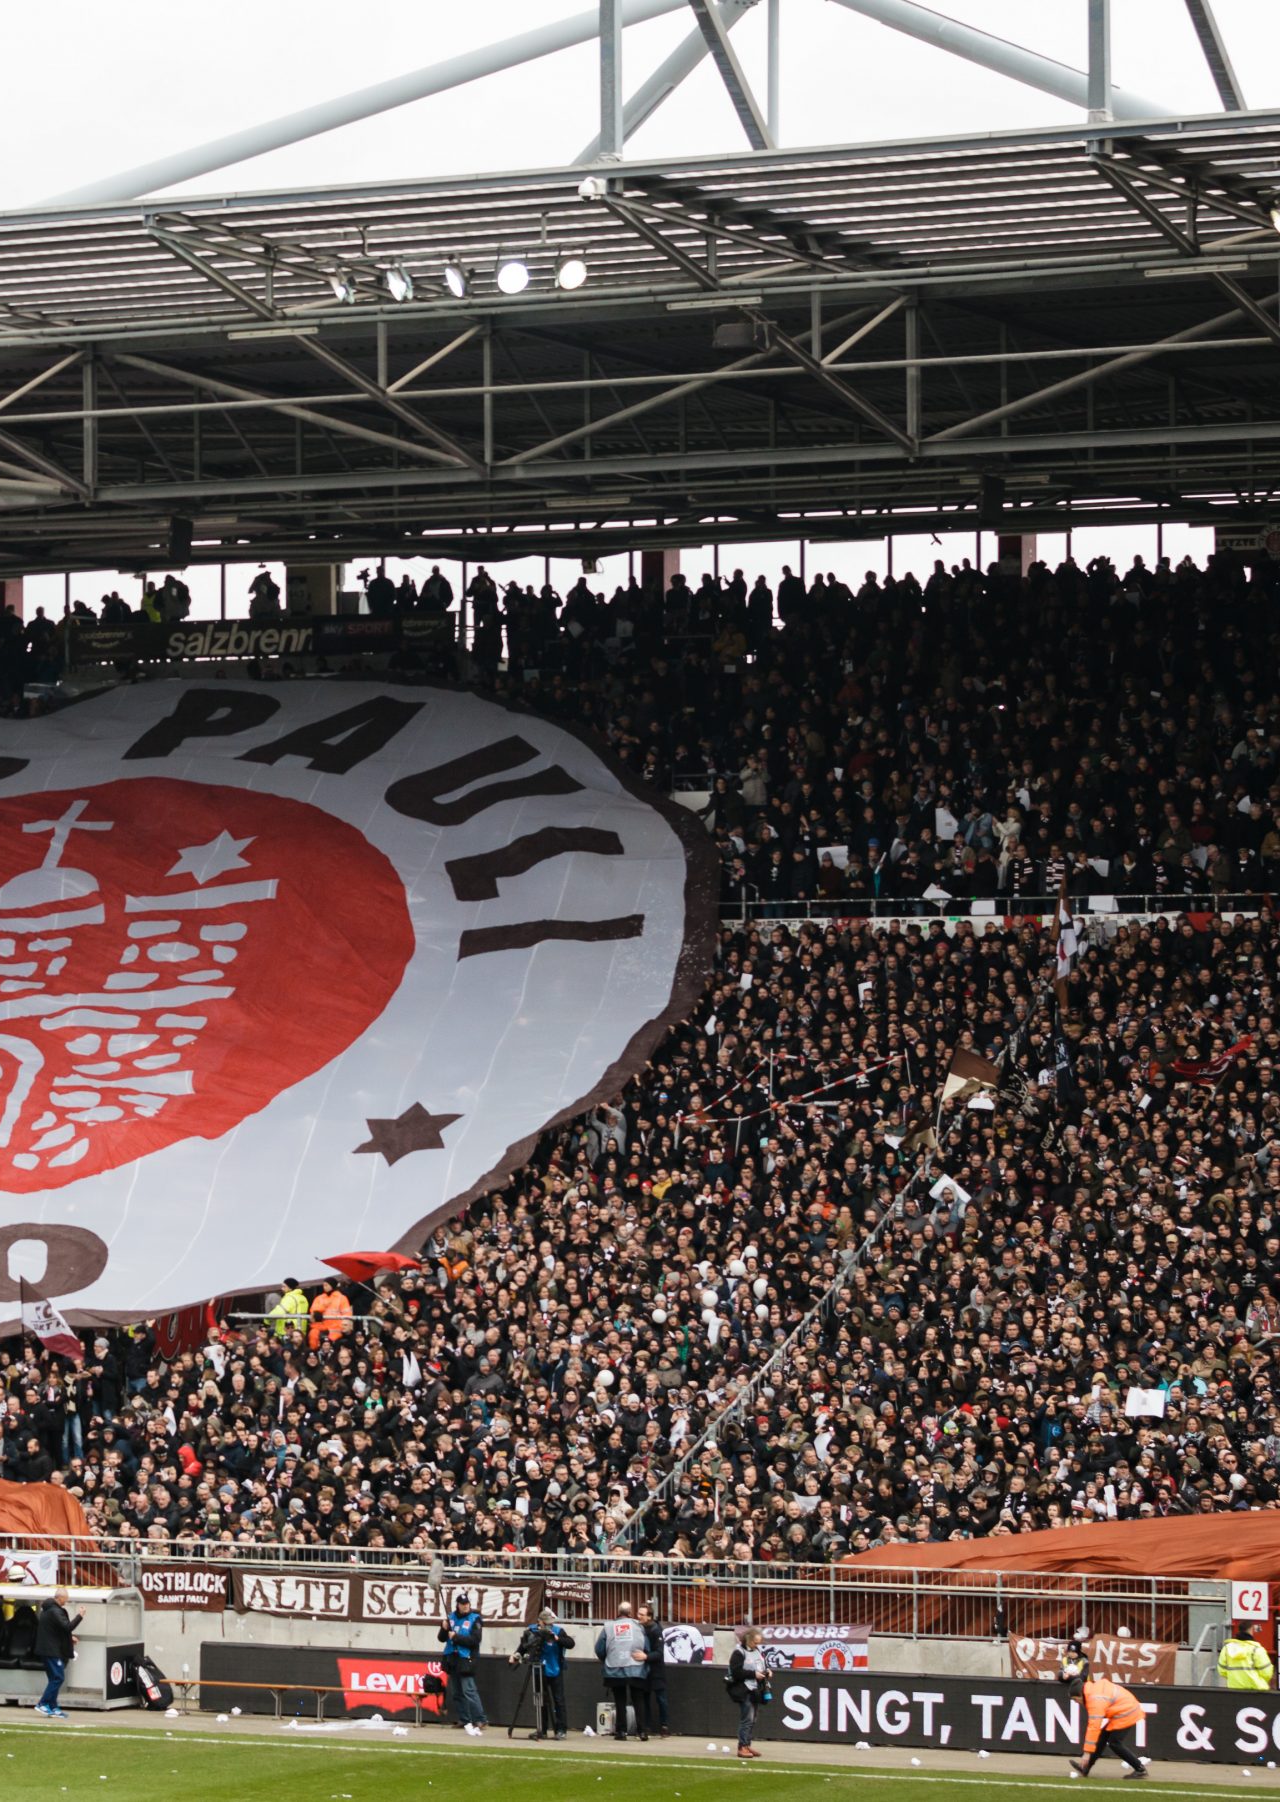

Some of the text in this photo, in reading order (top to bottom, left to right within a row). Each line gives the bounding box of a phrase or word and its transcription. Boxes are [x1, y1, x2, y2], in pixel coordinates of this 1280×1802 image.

[347, 621, 392, 635] SPORT
[123, 686, 646, 962] PAULI
[142, 1572, 226, 1594] OSTBLOCK
[246, 1577, 346, 1613] ALTE
[186, 1595, 209, 1604] PAULI
[1238, 1589, 1262, 1611] C2
[1016, 1638, 1162, 1668] OFFNES
[782, 1685, 953, 1744] SINGT,
[971, 1694, 1158, 1748] TANT
[1177, 1704, 1215, 1750] &
